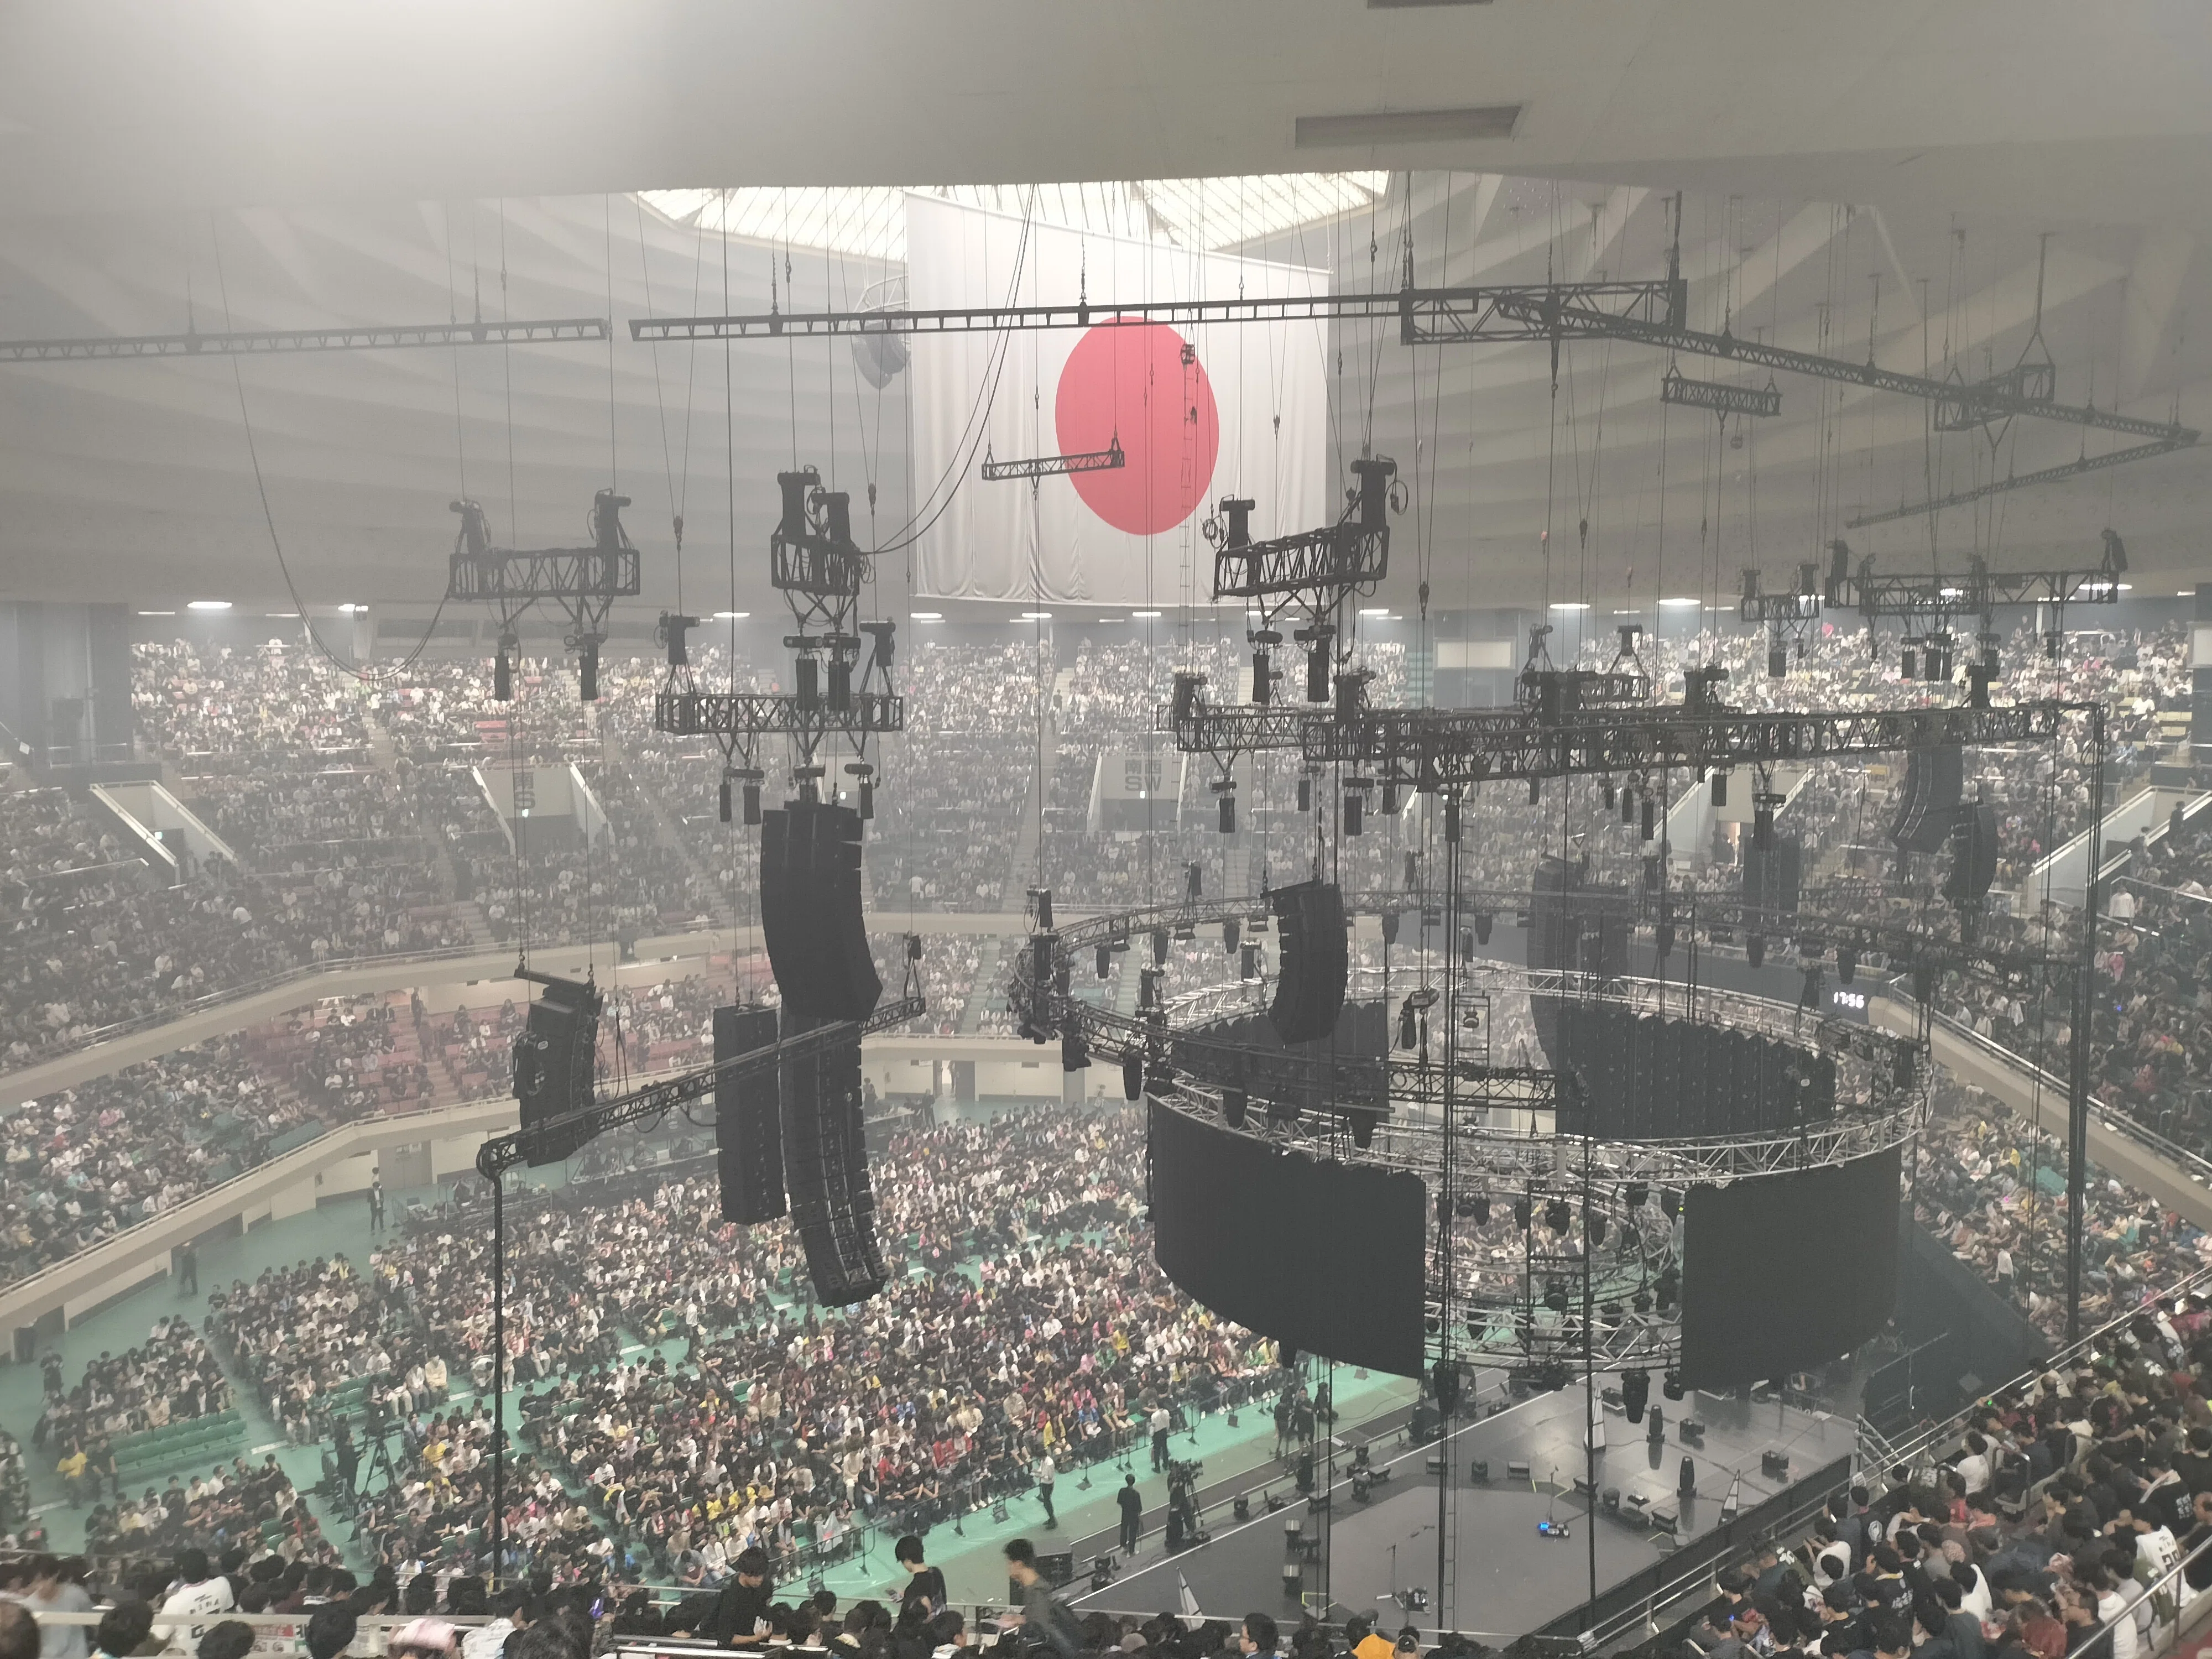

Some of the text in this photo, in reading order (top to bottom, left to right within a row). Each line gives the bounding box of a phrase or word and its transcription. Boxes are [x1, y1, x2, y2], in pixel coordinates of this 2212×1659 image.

[1124, 759, 1162, 775] 南西
[1125, 776, 1162, 791] SW
[515, 791, 535, 810] S
[1833, 992, 1864, 1009] 17:56
